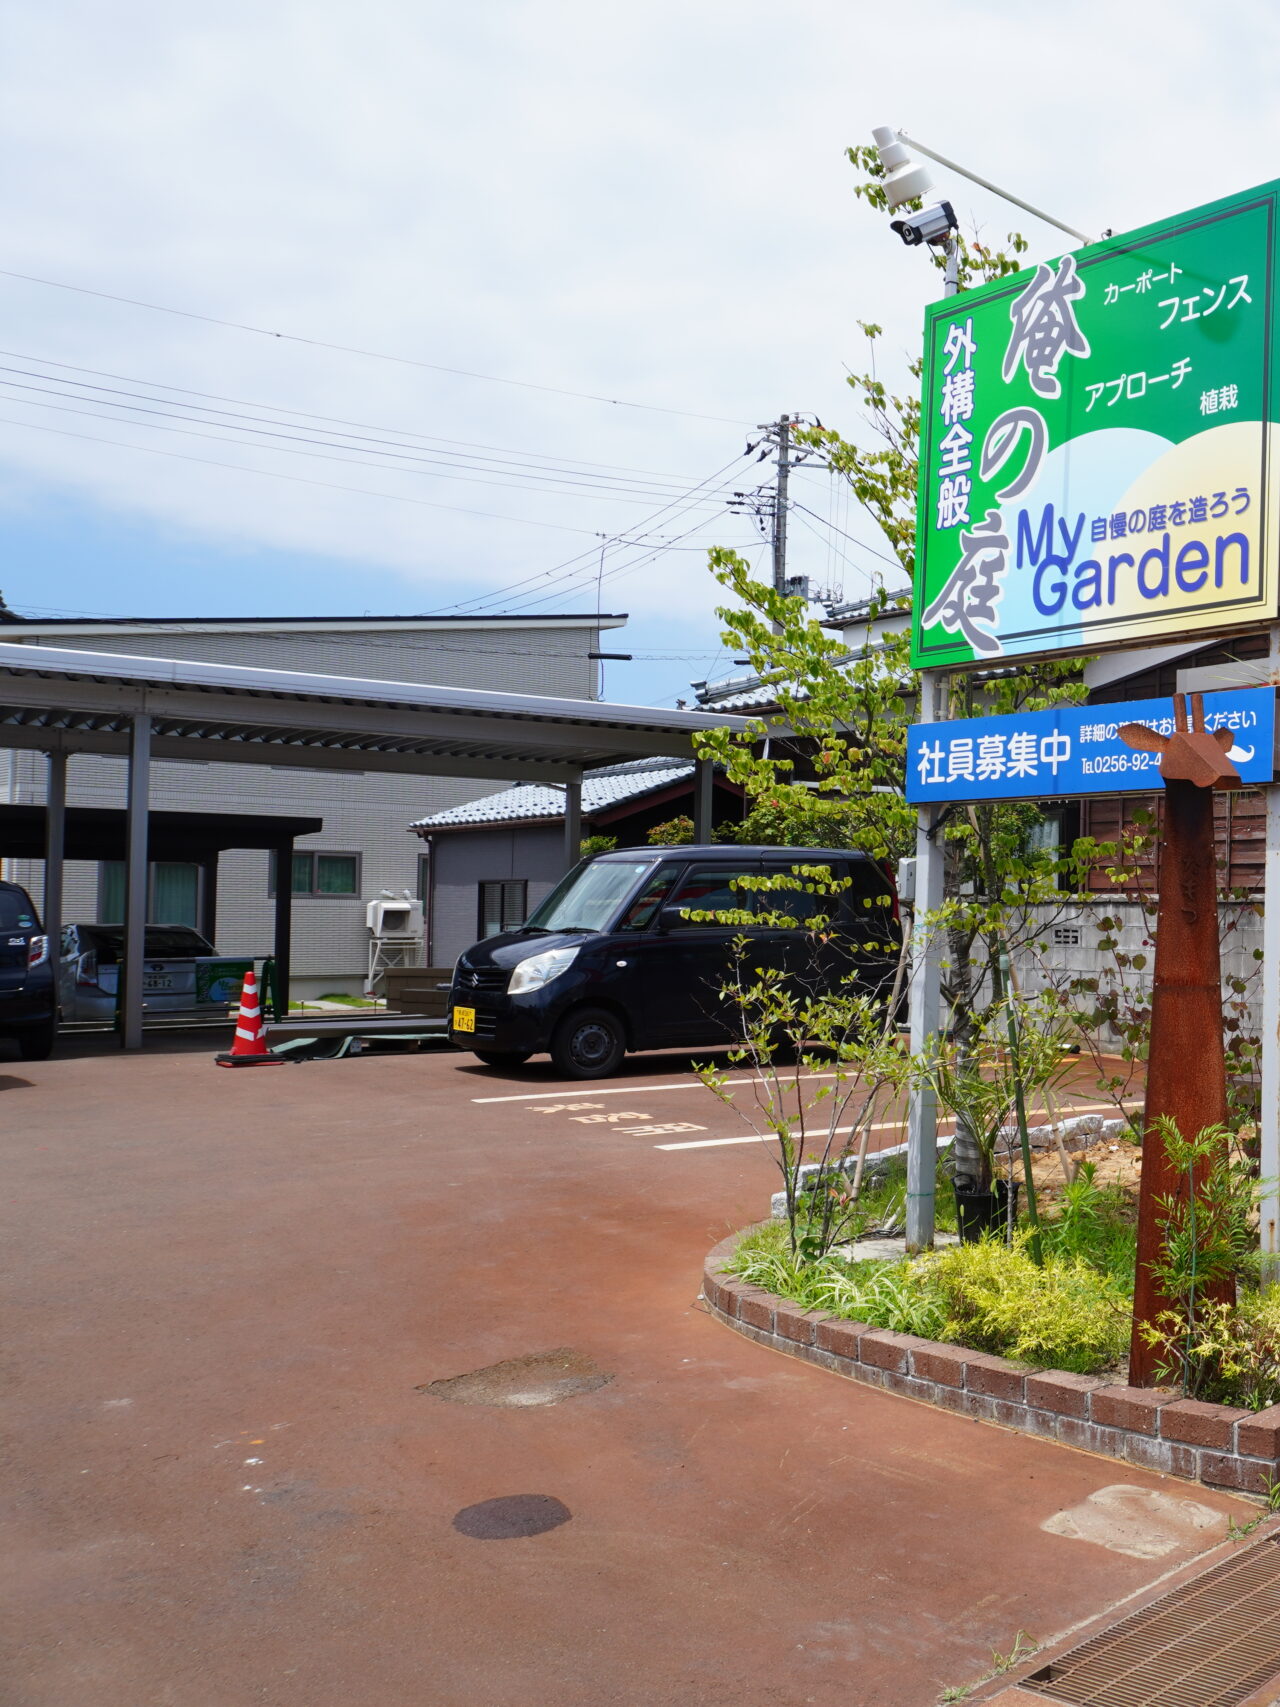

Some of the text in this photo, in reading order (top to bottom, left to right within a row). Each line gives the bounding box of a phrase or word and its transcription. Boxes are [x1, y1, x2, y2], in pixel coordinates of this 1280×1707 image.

[1104, 263, 1182, 305] カーポート
[1158, 275, 1252, 329] フェンス
[1084, 357, 1192, 412] アプローチ
[1199, 384, 1239, 416] 植栽
[936, 317, 977, 531] 外構全般
[1016, 503, 1086, 570] My
[1090, 487, 1251, 545] 自慢の庭を造ろう
[1033, 531, 1249, 616] Garden
[917, 728, 1072, 785] 社員募集中
